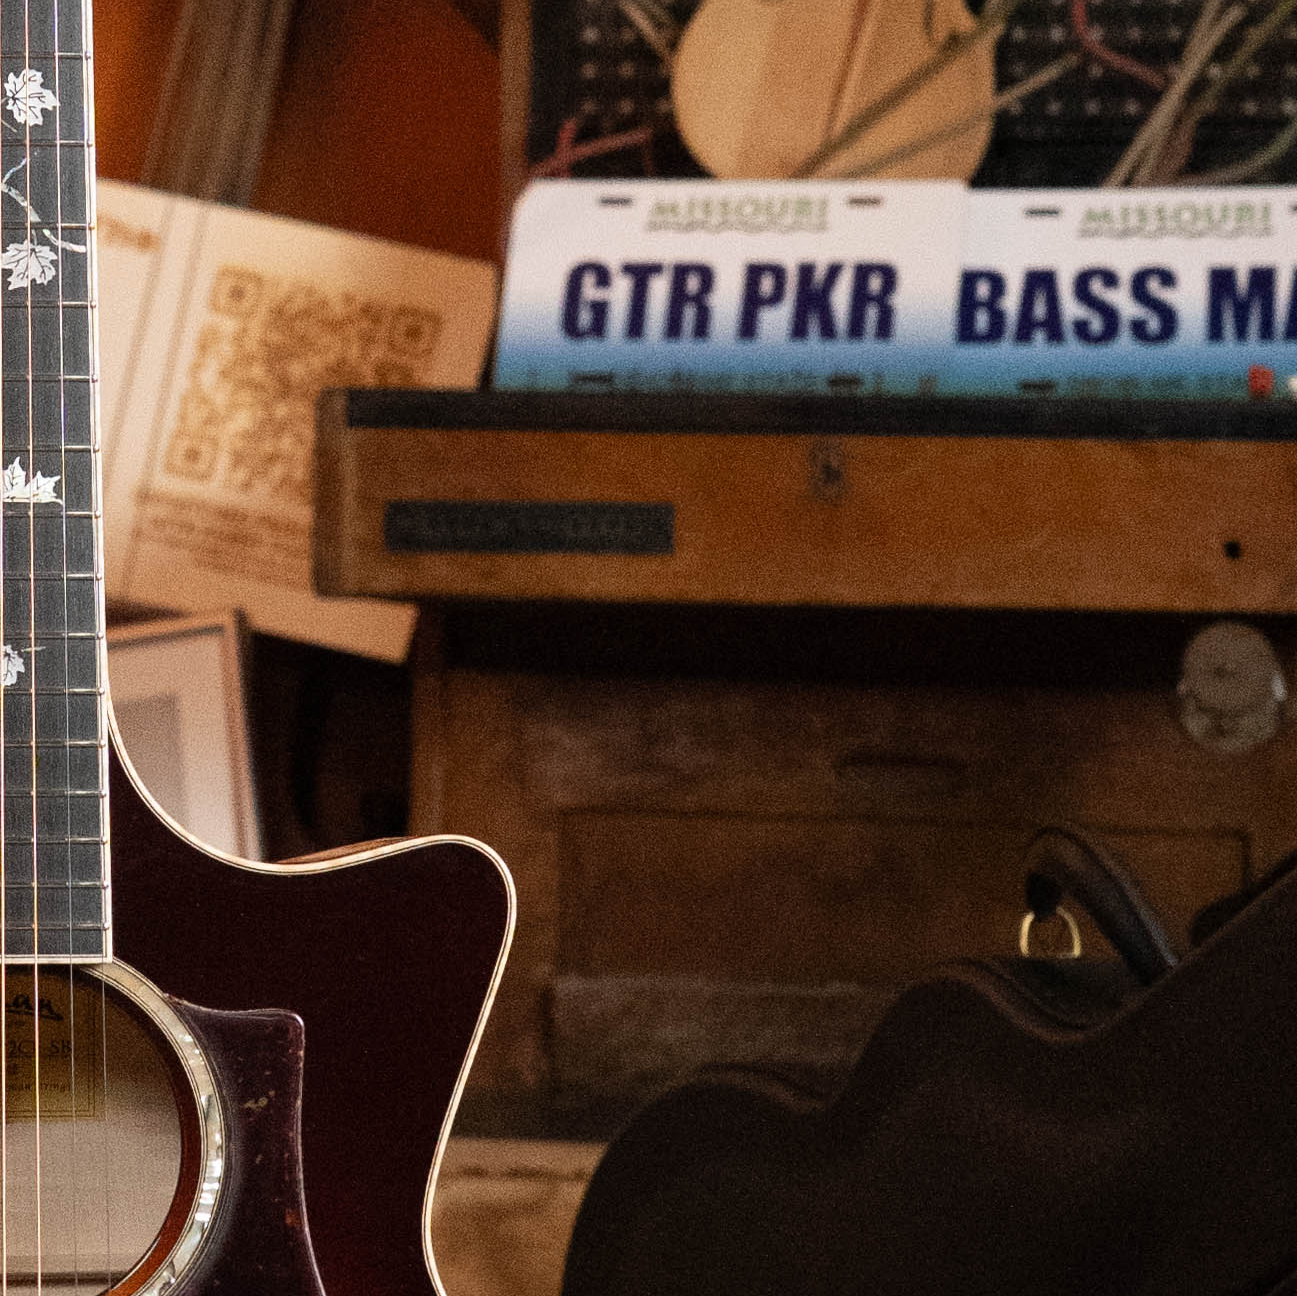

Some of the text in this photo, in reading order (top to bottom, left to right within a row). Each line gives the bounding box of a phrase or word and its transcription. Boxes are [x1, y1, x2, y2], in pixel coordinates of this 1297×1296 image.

[646, 196, 831, 233] MISSOURI
[1079, 204, 1277, 239] MISSOURI
[560, 262, 900, 342] GTR PKR
[954, 266, 1297, 348] BASS M
